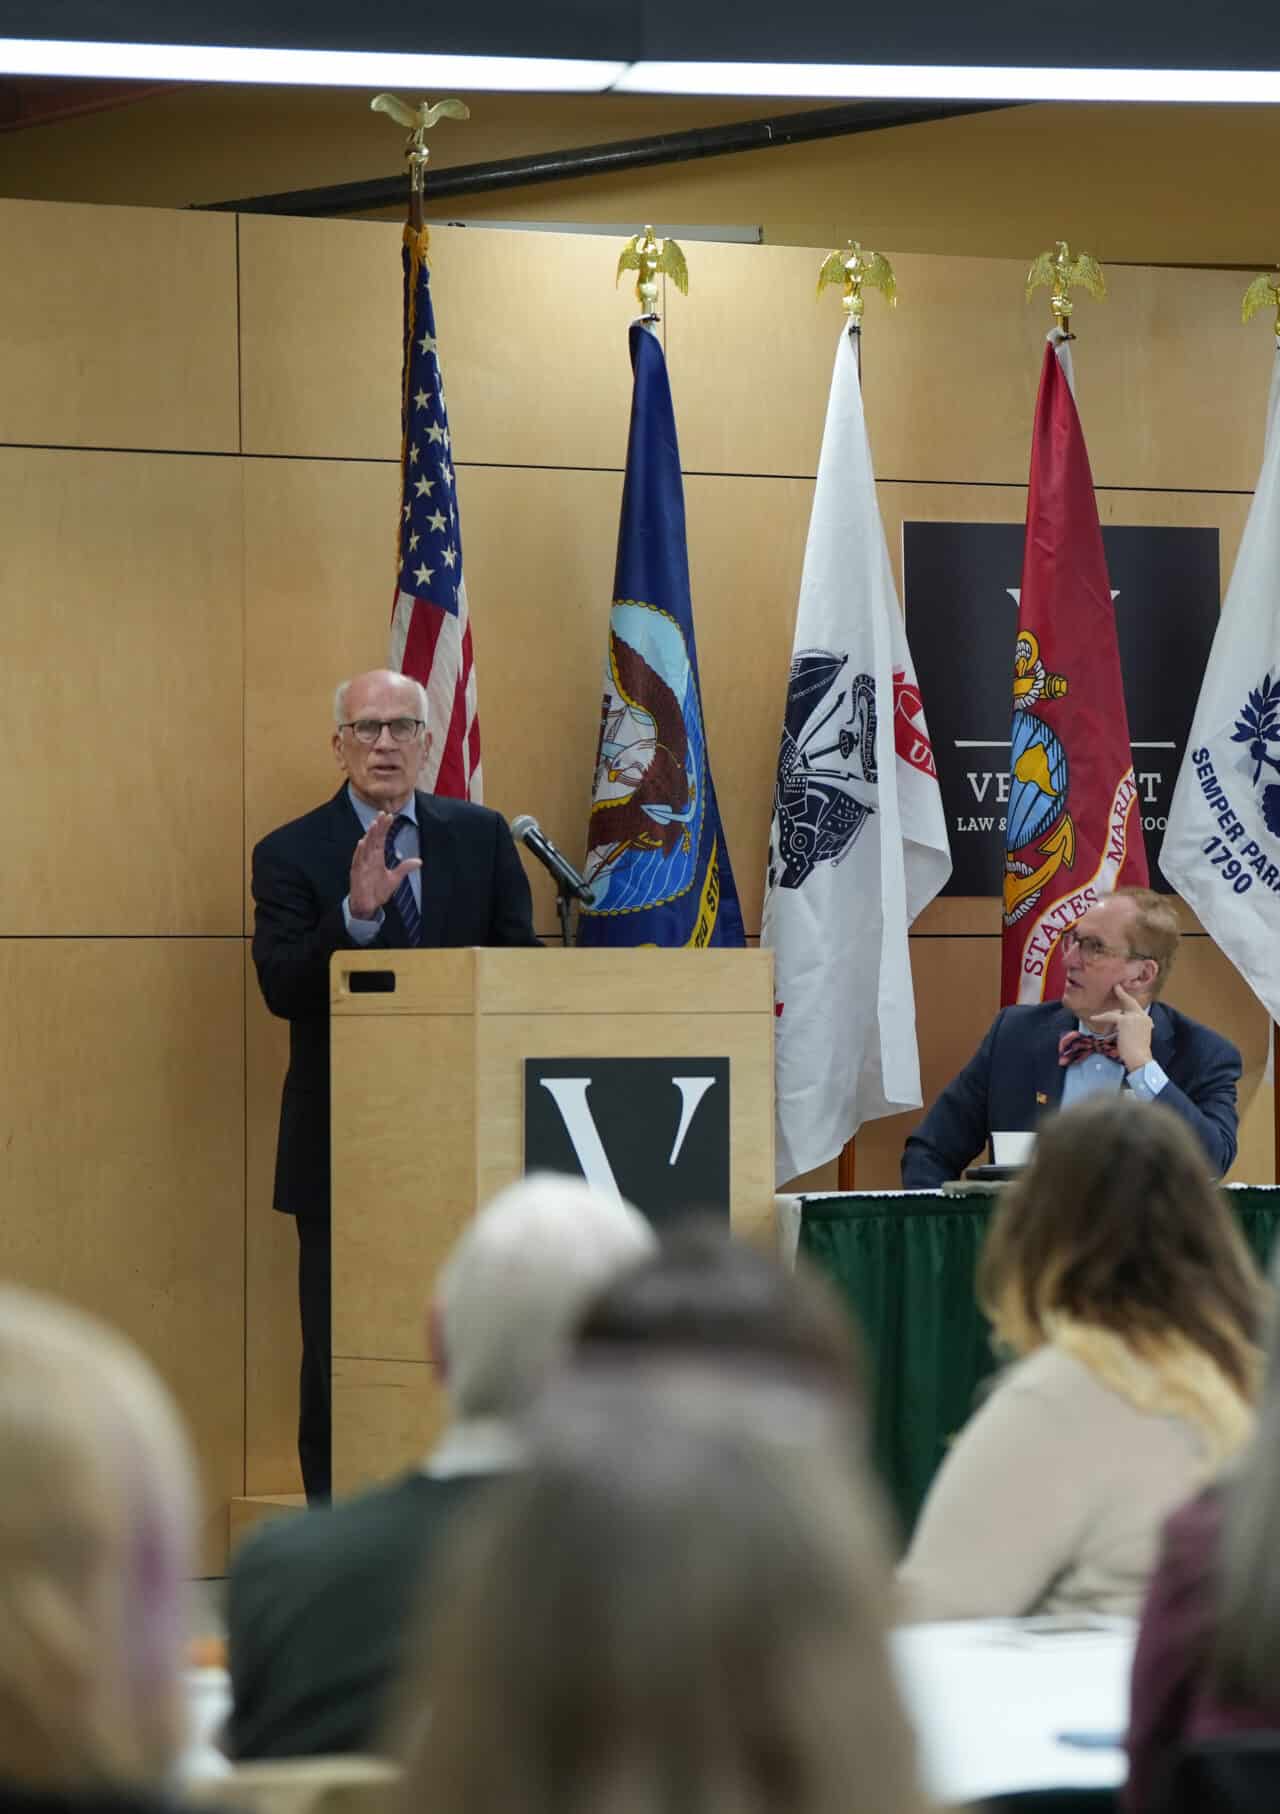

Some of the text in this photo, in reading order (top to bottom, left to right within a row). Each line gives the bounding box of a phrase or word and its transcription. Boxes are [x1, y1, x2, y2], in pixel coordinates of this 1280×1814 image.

[956, 816, 995, 832] LAW
[998, 816, 1008, 831] &
[1191, 747, 1246, 843] SEMPER
[1201, 835, 1254, 896] 1790
[1023, 886, 1099, 978] STATES
